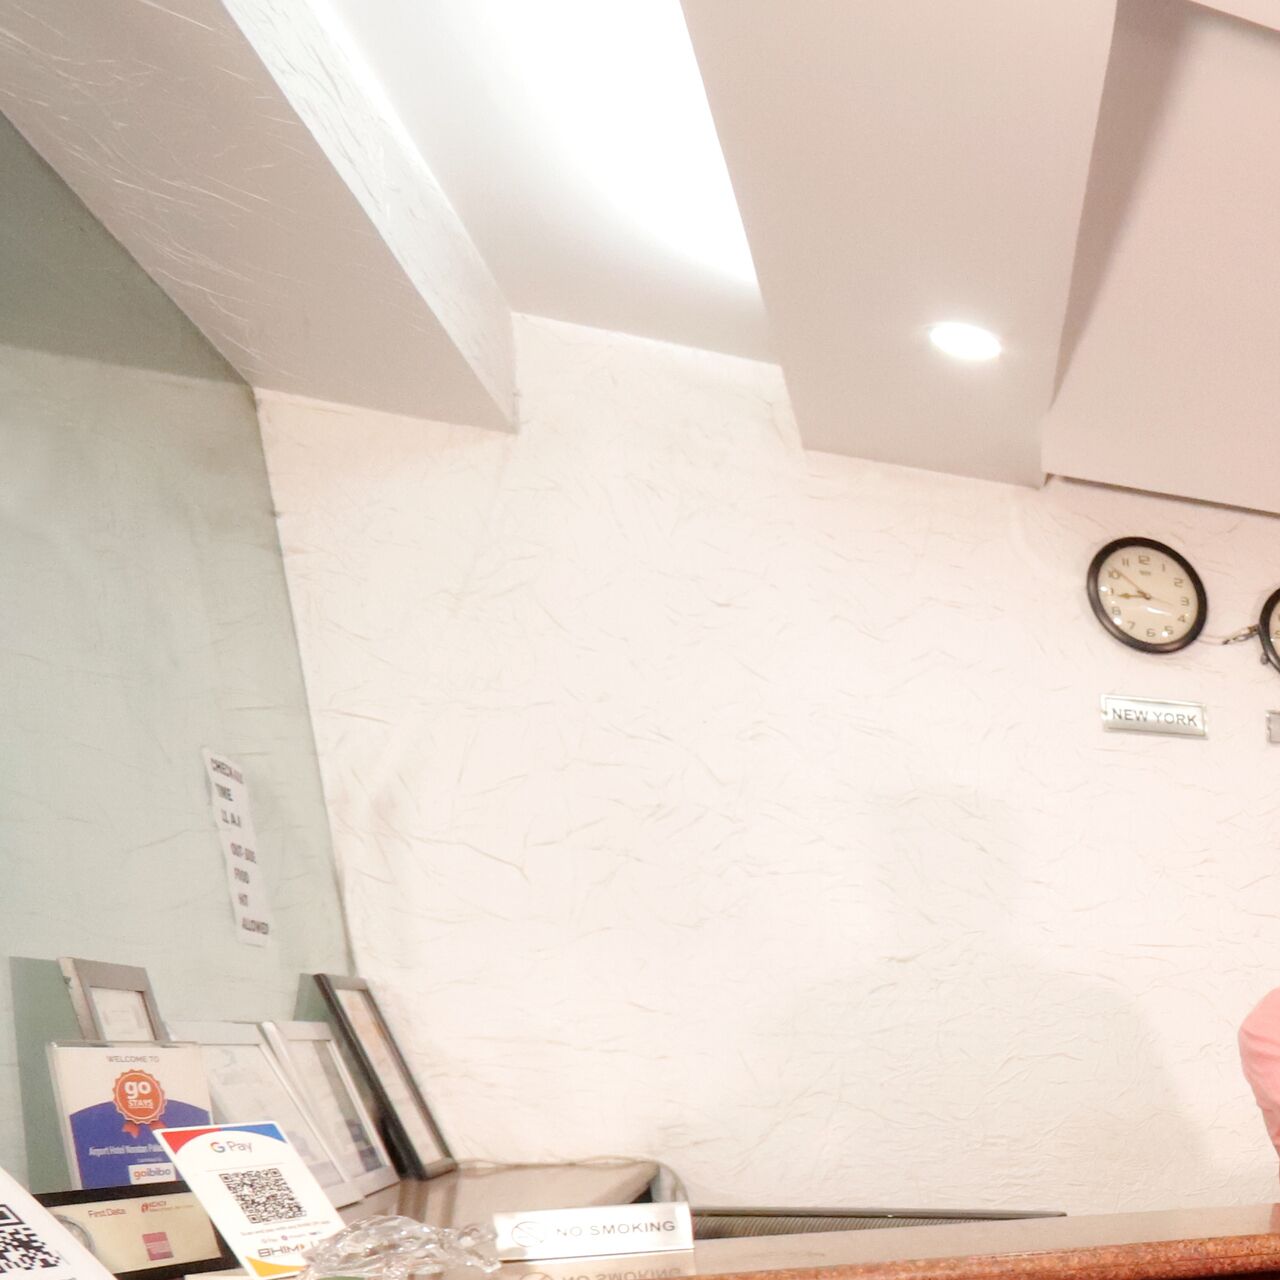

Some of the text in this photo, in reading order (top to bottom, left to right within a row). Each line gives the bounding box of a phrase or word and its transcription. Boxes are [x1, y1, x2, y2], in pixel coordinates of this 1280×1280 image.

[1139, 555, 1150, 565] 12
[1174, 578, 1183, 587] 2
[1181, 597, 1189, 606] 3
[1112, 607, 1121, 616] 8
[1178, 615, 1186, 623] 4
[1128, 621, 1135, 630] 7
[1147, 628, 1155, 637] 6
[1112, 708, 1198, 728] NEW YORK
[242, 917, 270, 936] ALLOWED
[106, 1055, 147, 1063] WELCOME
[124, 1080, 151, 1099] go
[128, 1099, 153, 1108] STAYS
[210, 1140, 253, 1153] G Pay
[133, 1168, 172, 1180] goibibo
[556, 1220, 677, 1237] NO SMOKING
[258, 1245, 300, 1258] BHIM
